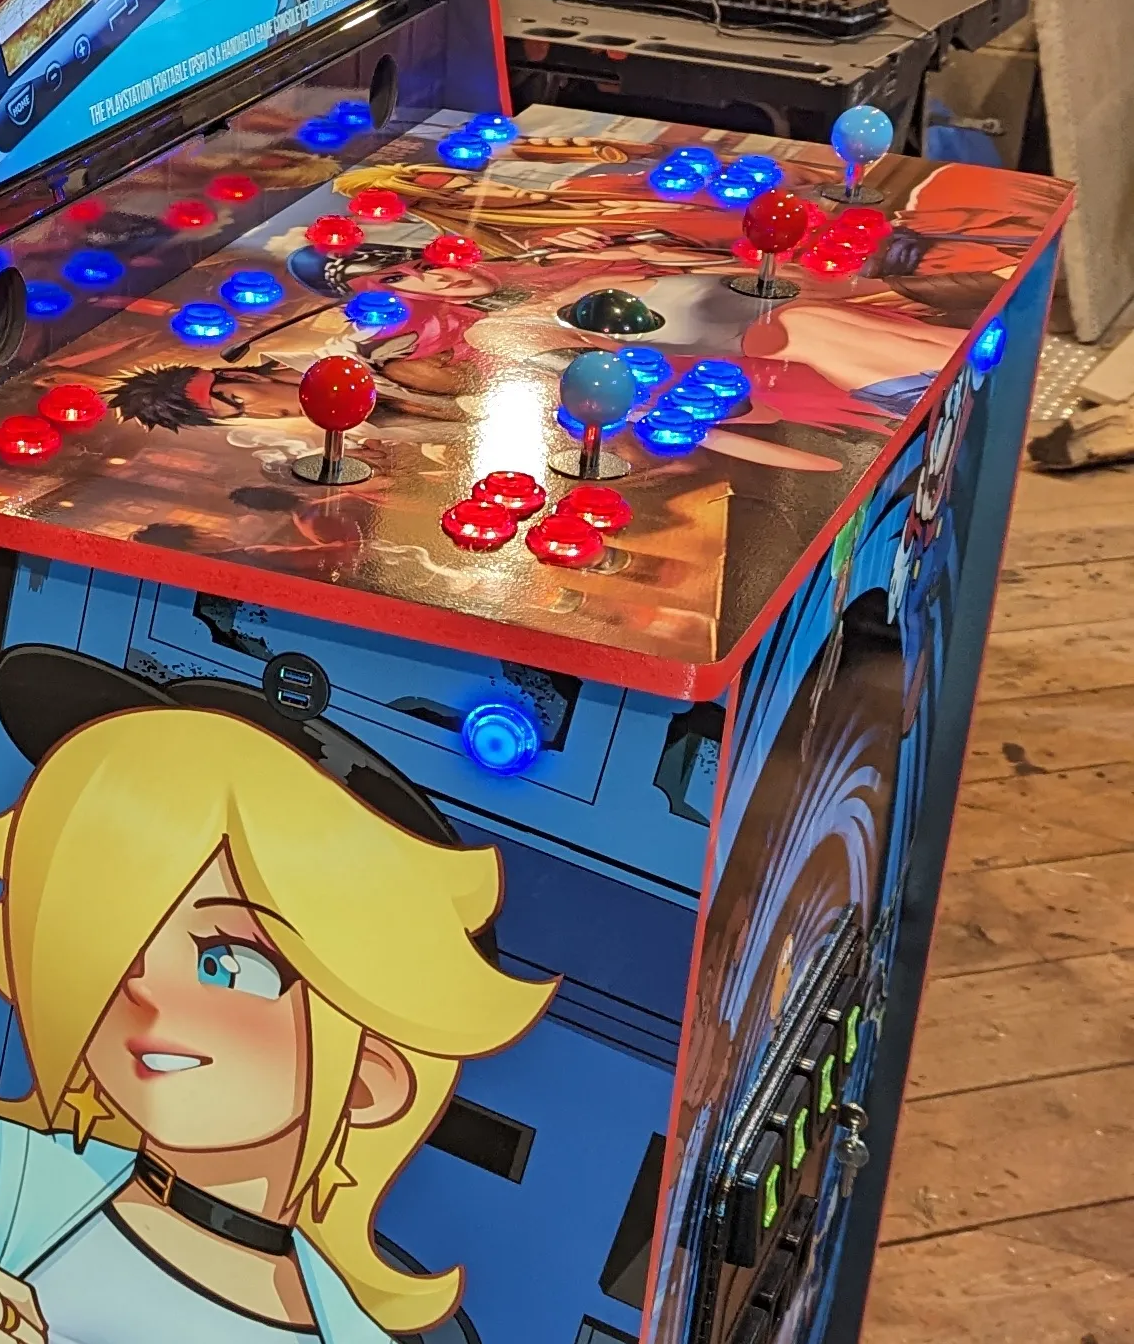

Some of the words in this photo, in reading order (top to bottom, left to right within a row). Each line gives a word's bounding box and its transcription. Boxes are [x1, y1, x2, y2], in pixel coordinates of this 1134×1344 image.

[89, 100, 106, 126] THE
[105, 79, 153, 119] PLAYSTATION
[152, 61, 189, 94] PORTABLE
[188, 51, 207, 76] (PSP)
[207, 46, 216, 67] IS
[221, 27, 255, 60] HANDHELD
[254, 19, 275, 43] GAME
[273, 5, 302, 35] CONSOLE
[12, 94, 30, 118] HOME
